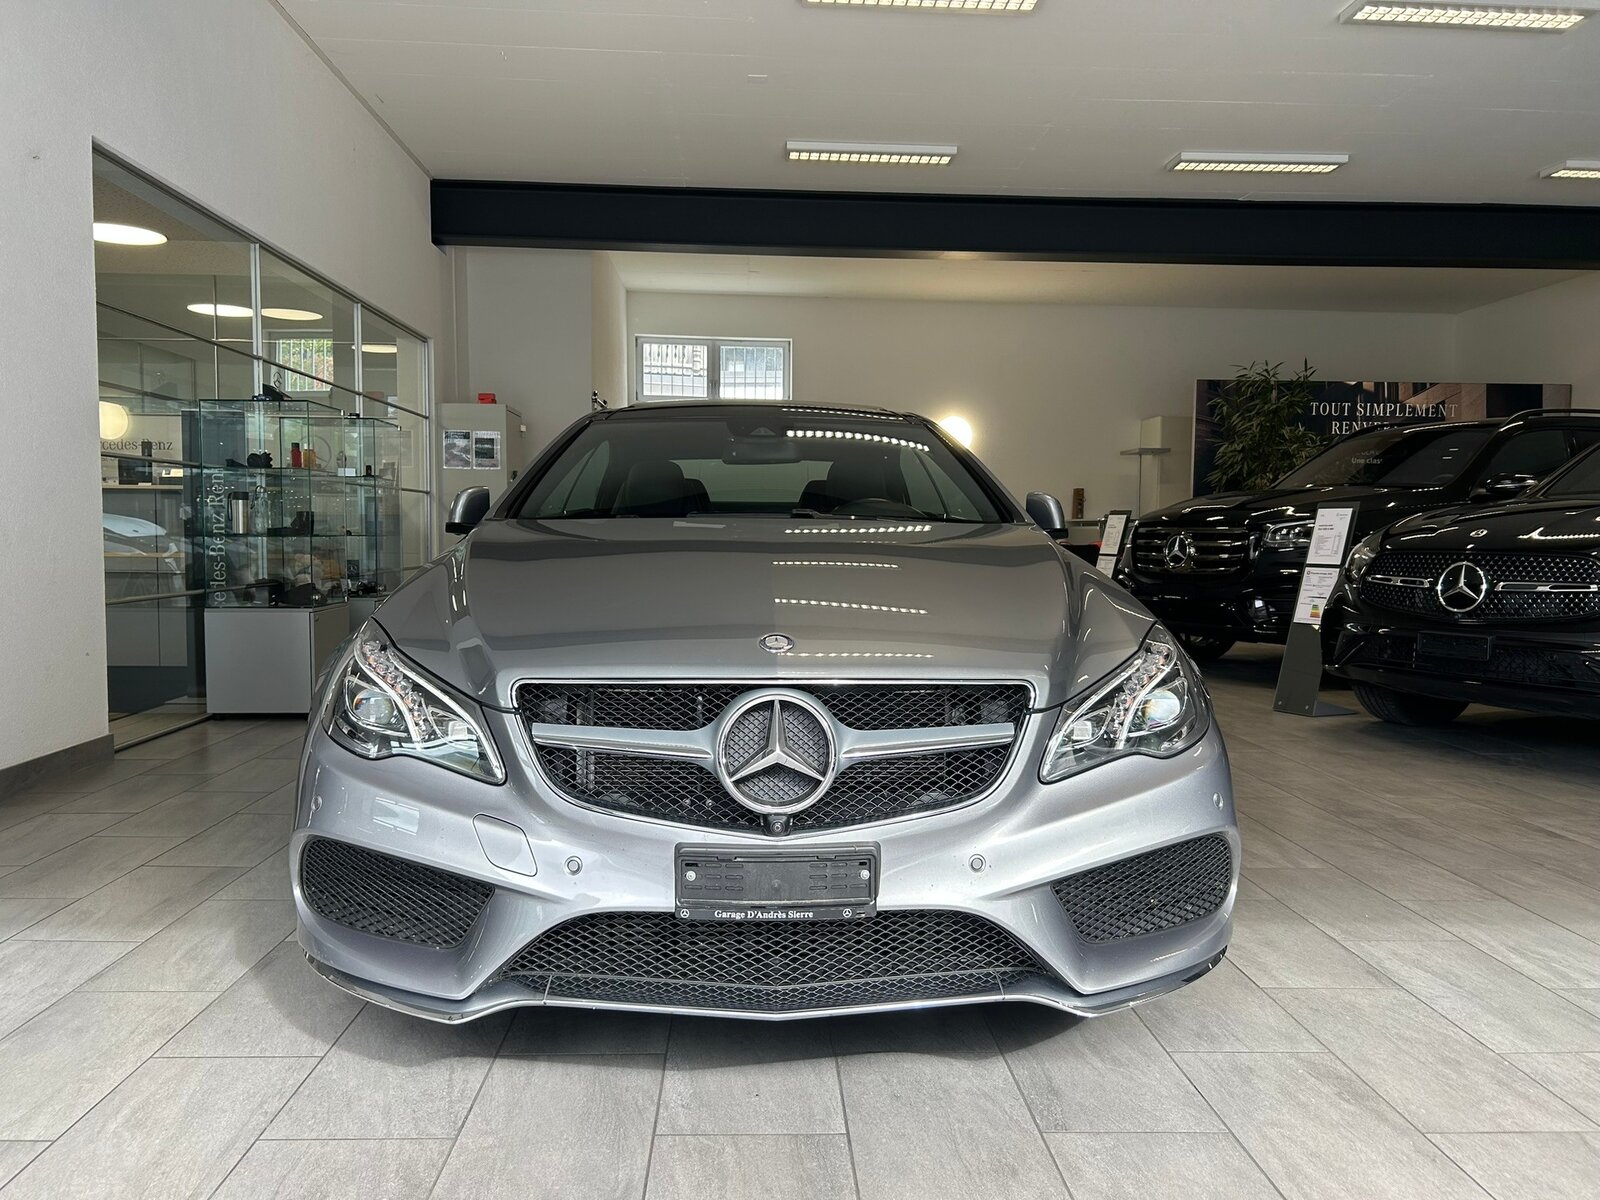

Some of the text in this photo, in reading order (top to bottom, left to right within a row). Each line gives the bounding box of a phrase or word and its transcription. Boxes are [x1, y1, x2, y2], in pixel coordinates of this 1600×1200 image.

[1310, 402, 1458, 418] TOUT SIMPLEMENT
[100, 438, 174, 451] cedes-enz
[714, 910, 814, 920] Garage D'Andrès Sierre
